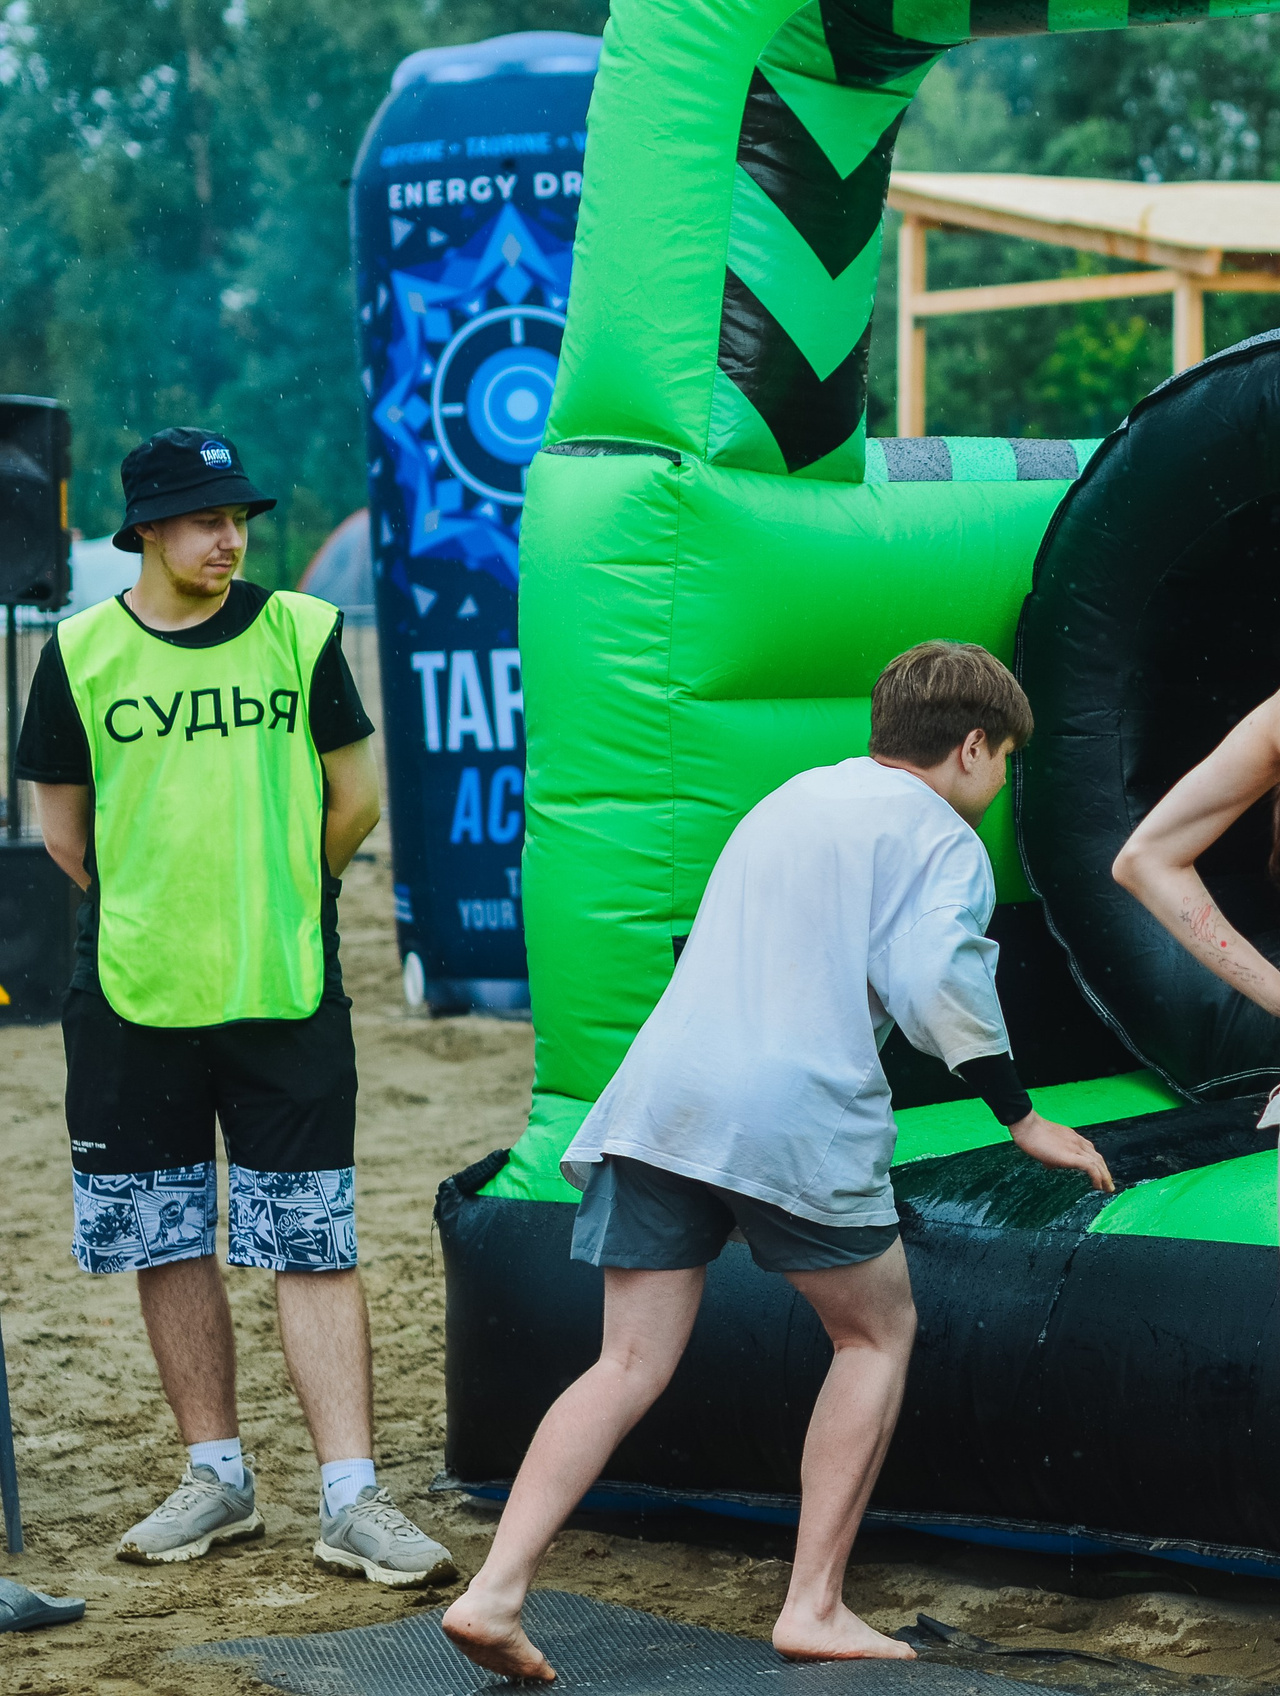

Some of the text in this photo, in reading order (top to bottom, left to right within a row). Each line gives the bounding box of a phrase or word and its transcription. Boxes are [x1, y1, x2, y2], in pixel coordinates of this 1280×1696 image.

[388, 172, 518, 211] ENERGY
[200, 448, 230, 462] TARGET
[104, 686, 299, 743] СУДЬЯ
[450, 764, 523, 845] AC
[457, 898, 517, 931] YOUR
